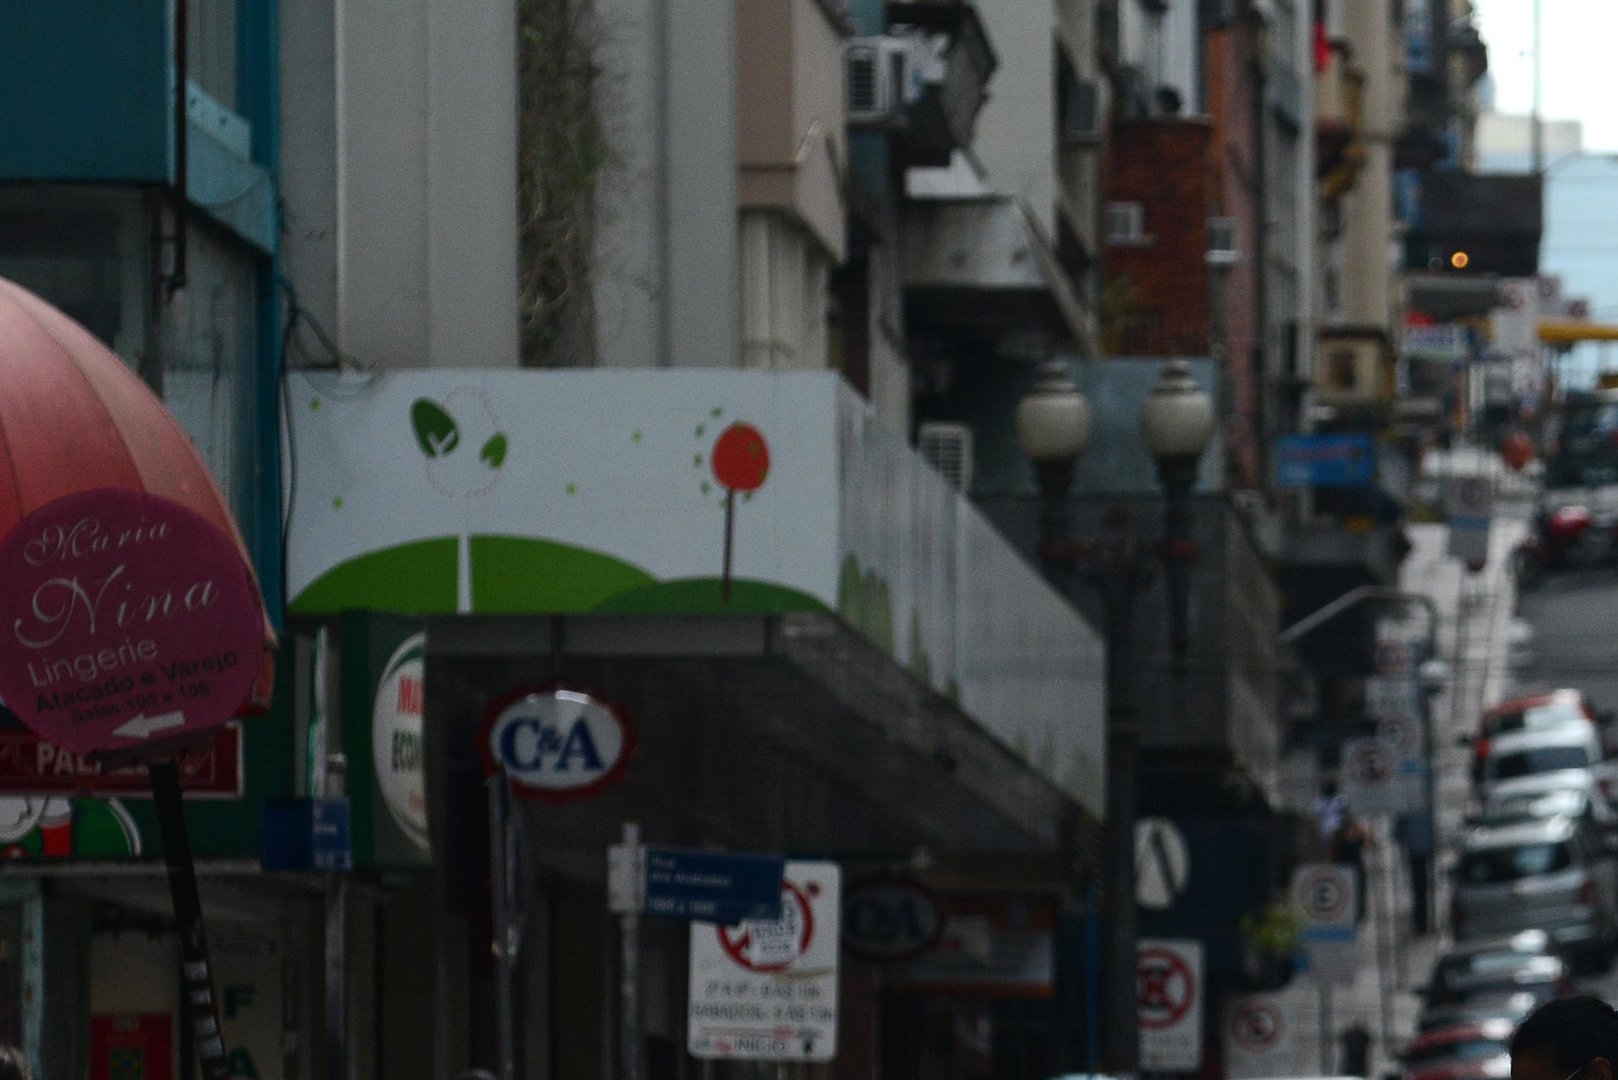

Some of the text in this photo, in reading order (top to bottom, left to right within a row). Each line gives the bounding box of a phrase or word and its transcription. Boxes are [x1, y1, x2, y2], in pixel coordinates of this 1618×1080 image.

[23, 515, 168, 568] Maria
[14, 563, 221, 649] Nina
[27, 636, 158, 689] Lingerie
[36, 648, 240, 714] Atacado e Varejo
[501, 716, 603, 773] C&A
